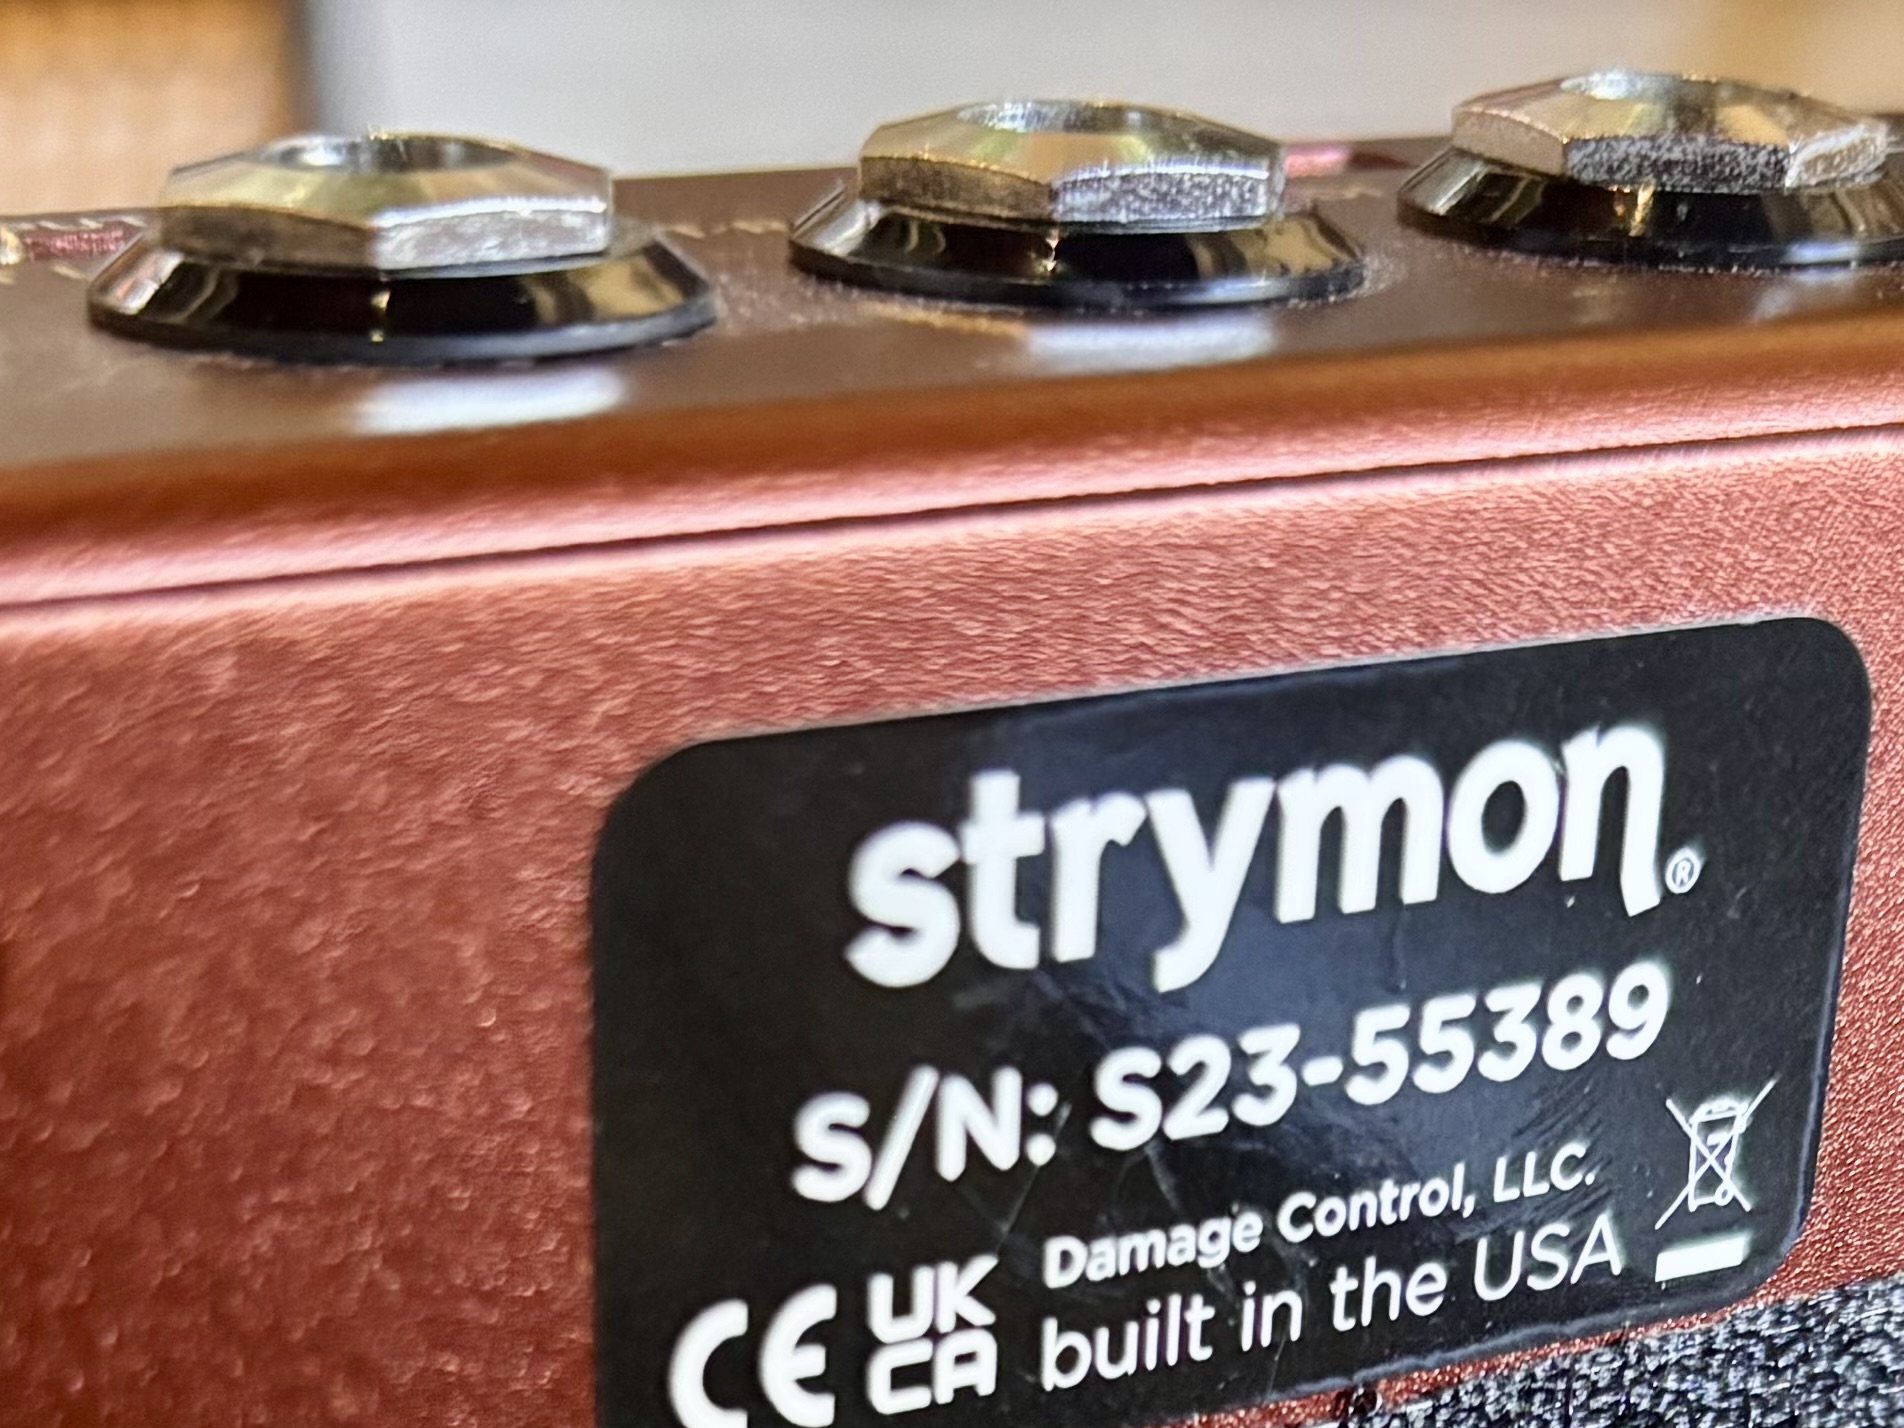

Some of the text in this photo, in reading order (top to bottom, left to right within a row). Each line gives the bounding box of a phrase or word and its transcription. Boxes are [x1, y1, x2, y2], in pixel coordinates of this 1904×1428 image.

[790, 957, 1674, 1211] S/N: S23-55389
[1042, 1138, 1598, 1292] Damage Control, LLC.
[865, 1253, 1000, 1344] UK
[865, 1328, 1000, 1417] CA
[1039, 1204, 1628, 1394] built in the USA
